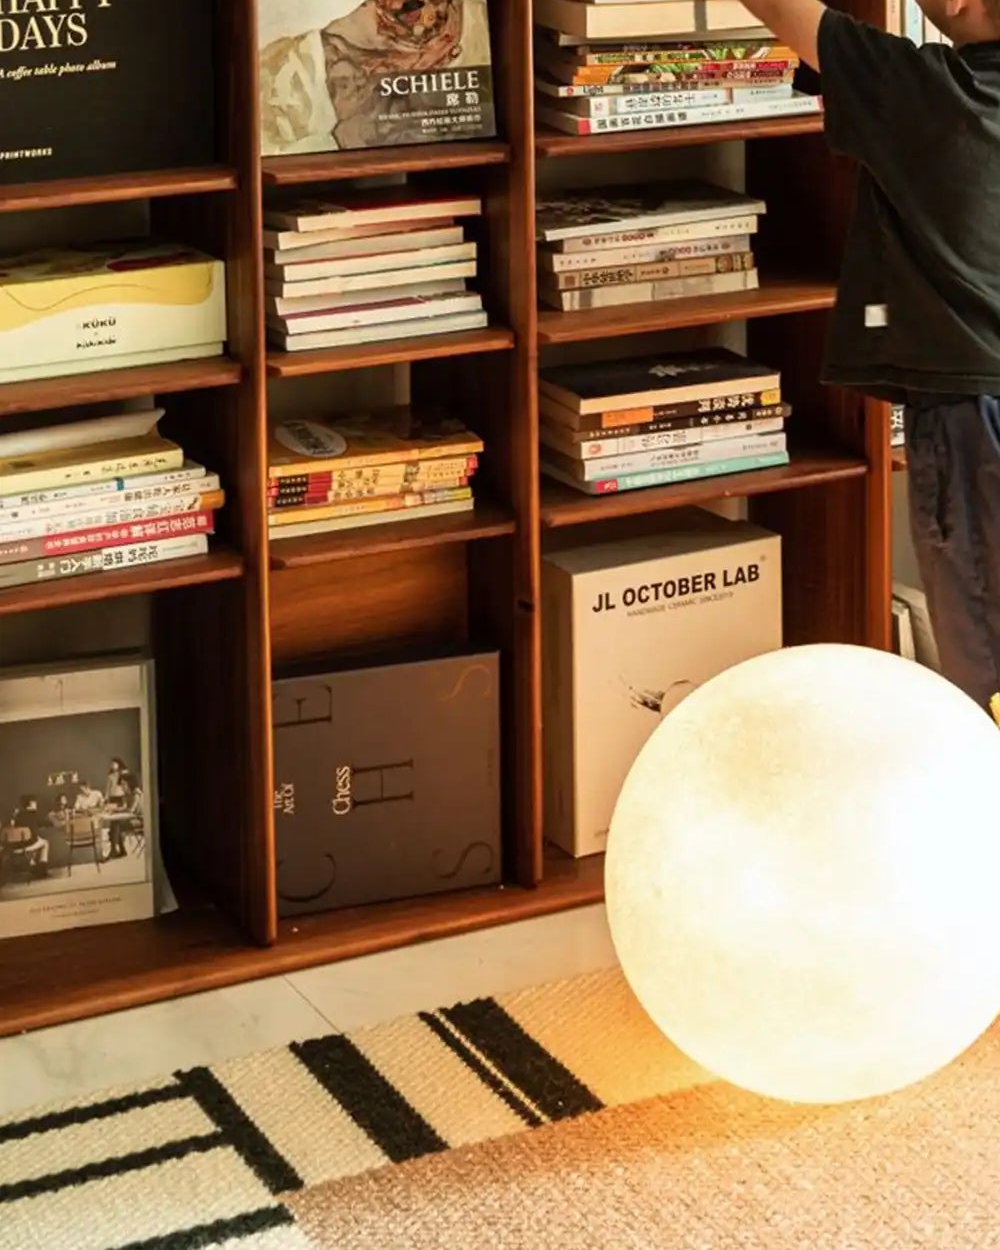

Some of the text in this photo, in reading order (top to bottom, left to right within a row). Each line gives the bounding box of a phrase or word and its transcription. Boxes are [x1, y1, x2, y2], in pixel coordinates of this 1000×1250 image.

[0, 12, 89, 52] DAYS
[6, 65, 33, 81] coffee
[34, 62, 57, 76] table
[58, 61, 85, 77] photo
[86, 59, 117, 71] album
[380, 70, 480, 97] SCHIELE
[0, 147, 53, 160] PRINTWORKS
[592, 563, 761, 614] JL OCTOBER LAB
[332, 765, 352, 816] Chess
